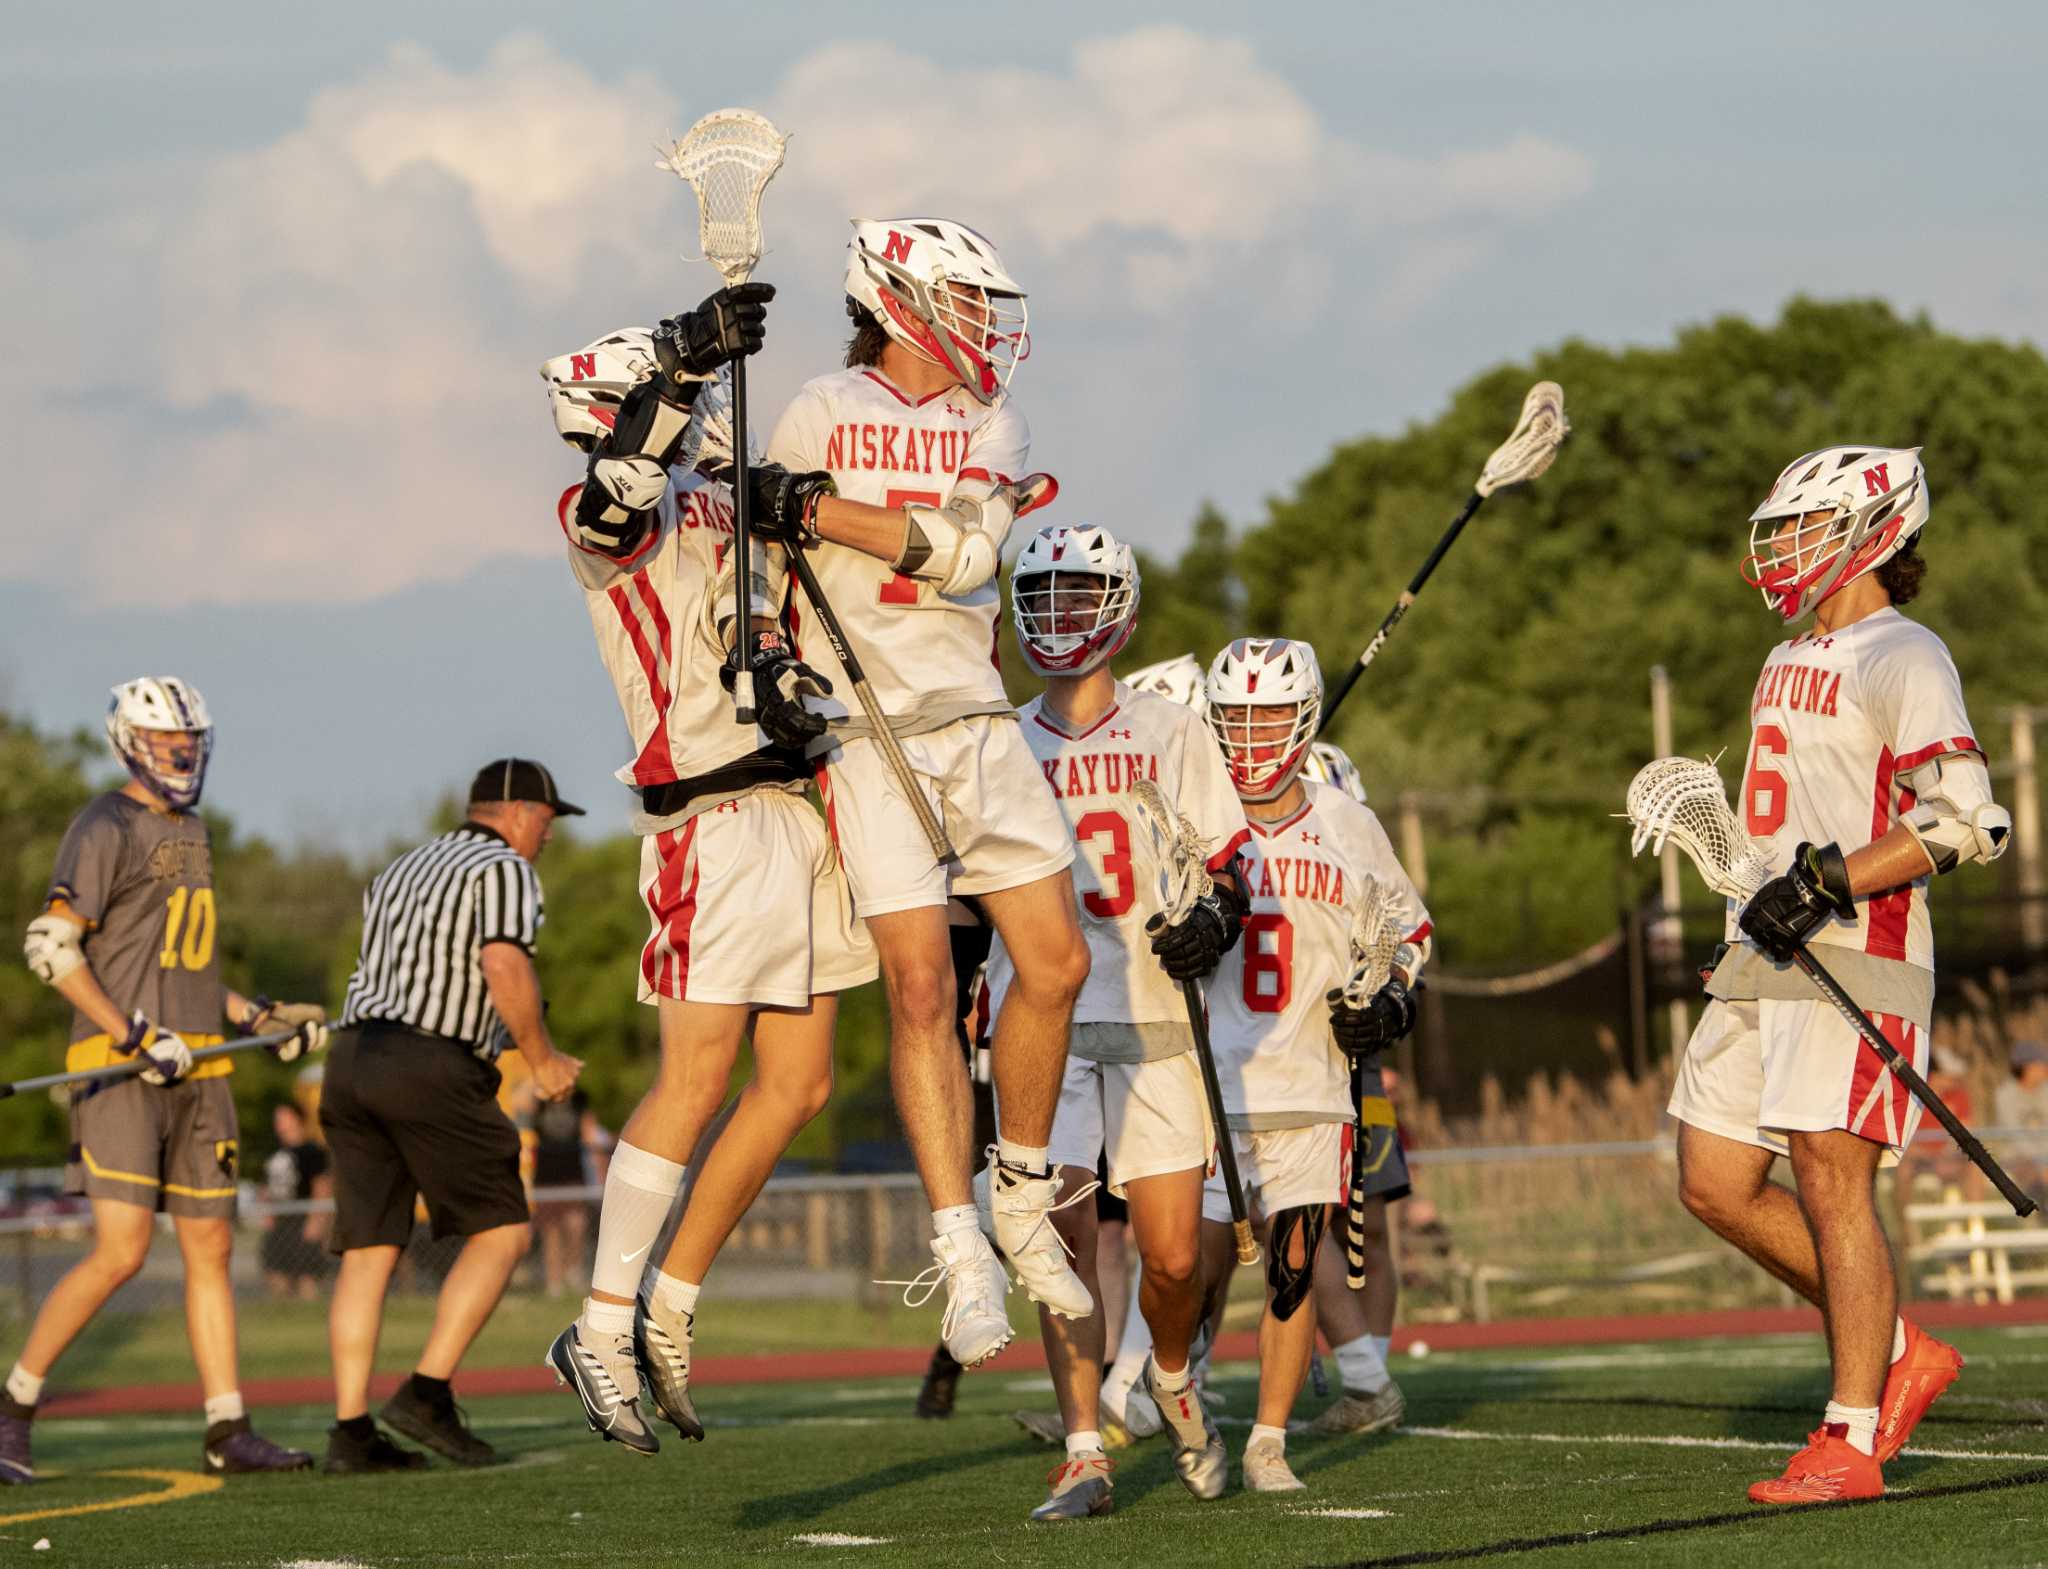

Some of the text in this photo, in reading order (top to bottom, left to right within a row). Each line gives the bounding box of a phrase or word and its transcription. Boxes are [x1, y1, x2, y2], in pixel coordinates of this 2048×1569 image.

[881, 230, 916, 264] N
[570, 352, 598, 381] N
[616, 475, 634, 492] STX
[1861, 462, 1890, 497] N
[1752, 664, 1841, 718] KAYUNA
[1746, 725, 1788, 837] 6
[1076, 811, 1136, 918] 3
[159, 885, 216, 971] 10
[1243, 913, 1294, 1013] 8
[1884, 1379, 1912, 1438] new balance
